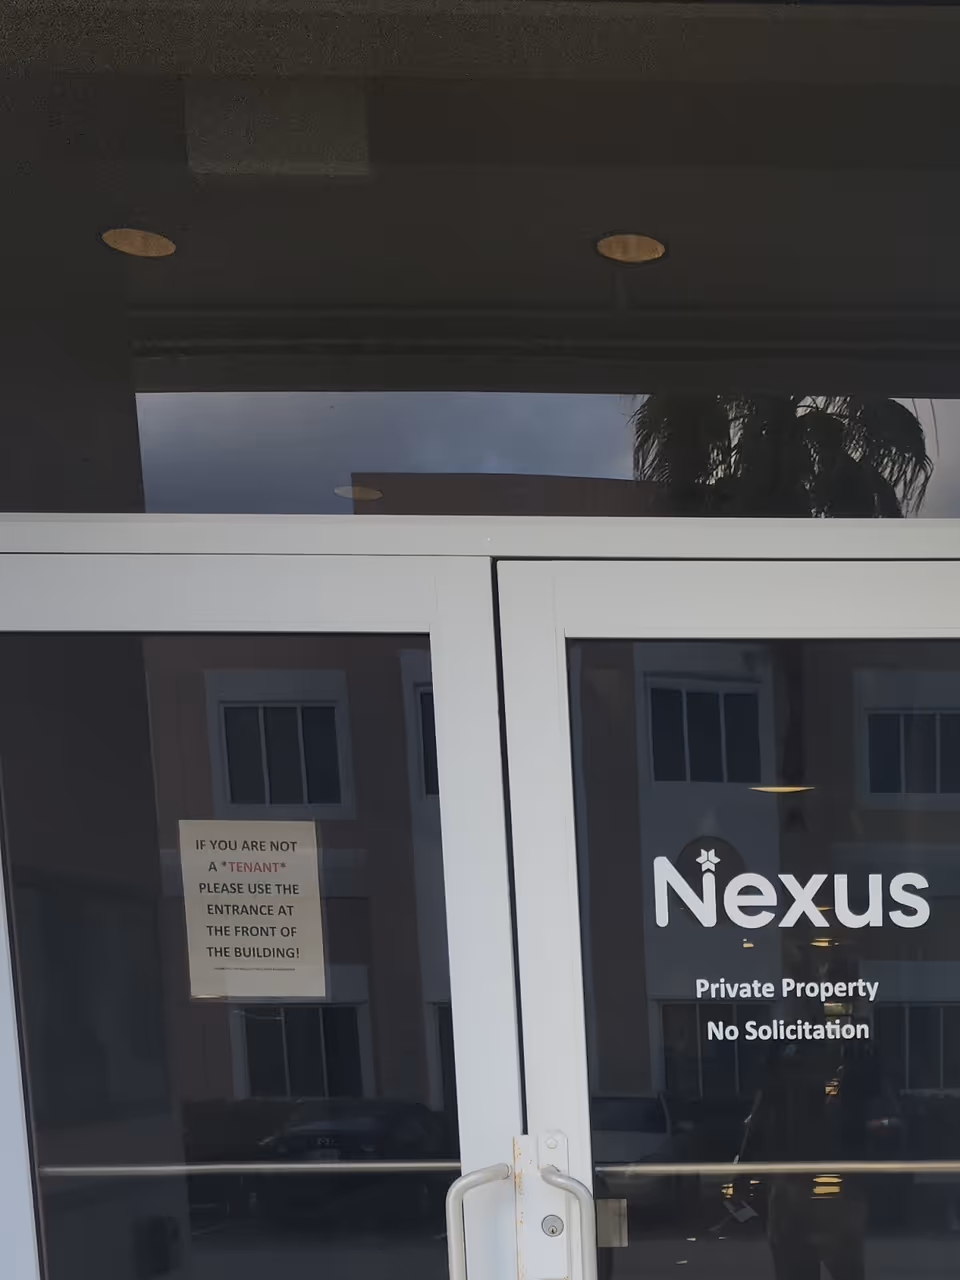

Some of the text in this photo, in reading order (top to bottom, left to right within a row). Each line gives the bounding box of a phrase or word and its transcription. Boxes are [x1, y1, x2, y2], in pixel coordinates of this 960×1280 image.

[196, 839, 298, 852] IF YOU ARE NOT
[208, 862, 218, 872] A
[199, 883, 300, 895] PLEASE USE THE
[653, 849, 930, 928] Nexus
[207, 904, 294, 916] ENTRANCE AT
[206, 926, 297, 937] THE FRONT OF
[206, 947, 300, 958] THE BUILDING!
[696, 978, 879, 1001] Private Property
[707, 1019, 870, 1040] No Solicitation
